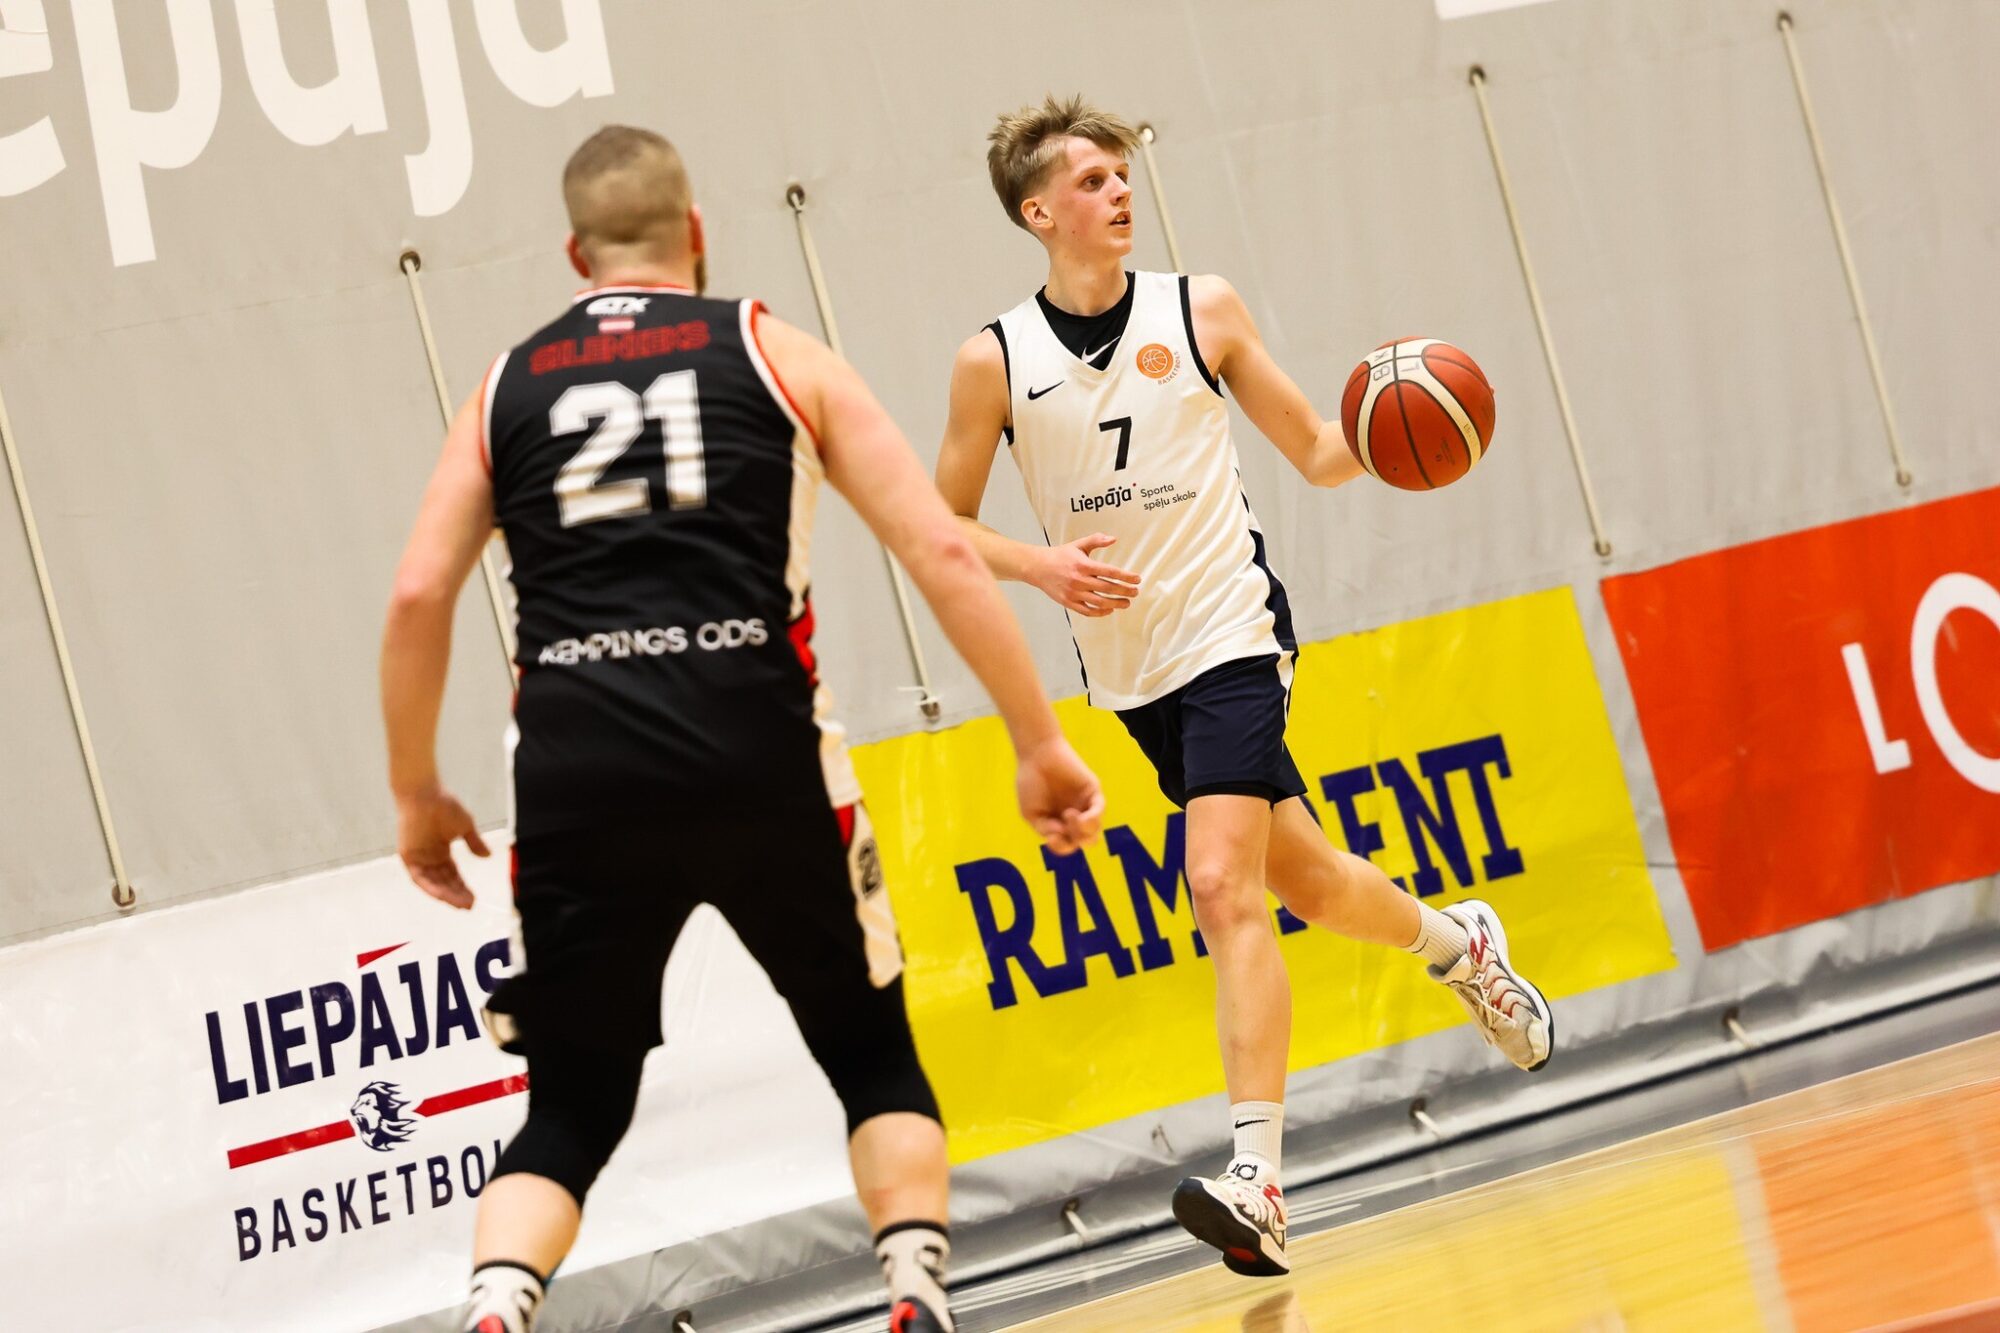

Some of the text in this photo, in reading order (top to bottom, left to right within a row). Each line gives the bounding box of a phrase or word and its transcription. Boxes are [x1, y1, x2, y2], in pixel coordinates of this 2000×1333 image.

[549, 369, 707, 529] 21
[1099, 416, 1132, 471] 7
[1070, 484, 1132, 513] Liepāja
[1140, 483, 1175, 500] Sporta
[1172, 489, 1197, 504] skola
[696, 618, 769, 652] ODS
[954, 734, 1525, 1010] RAMENT
